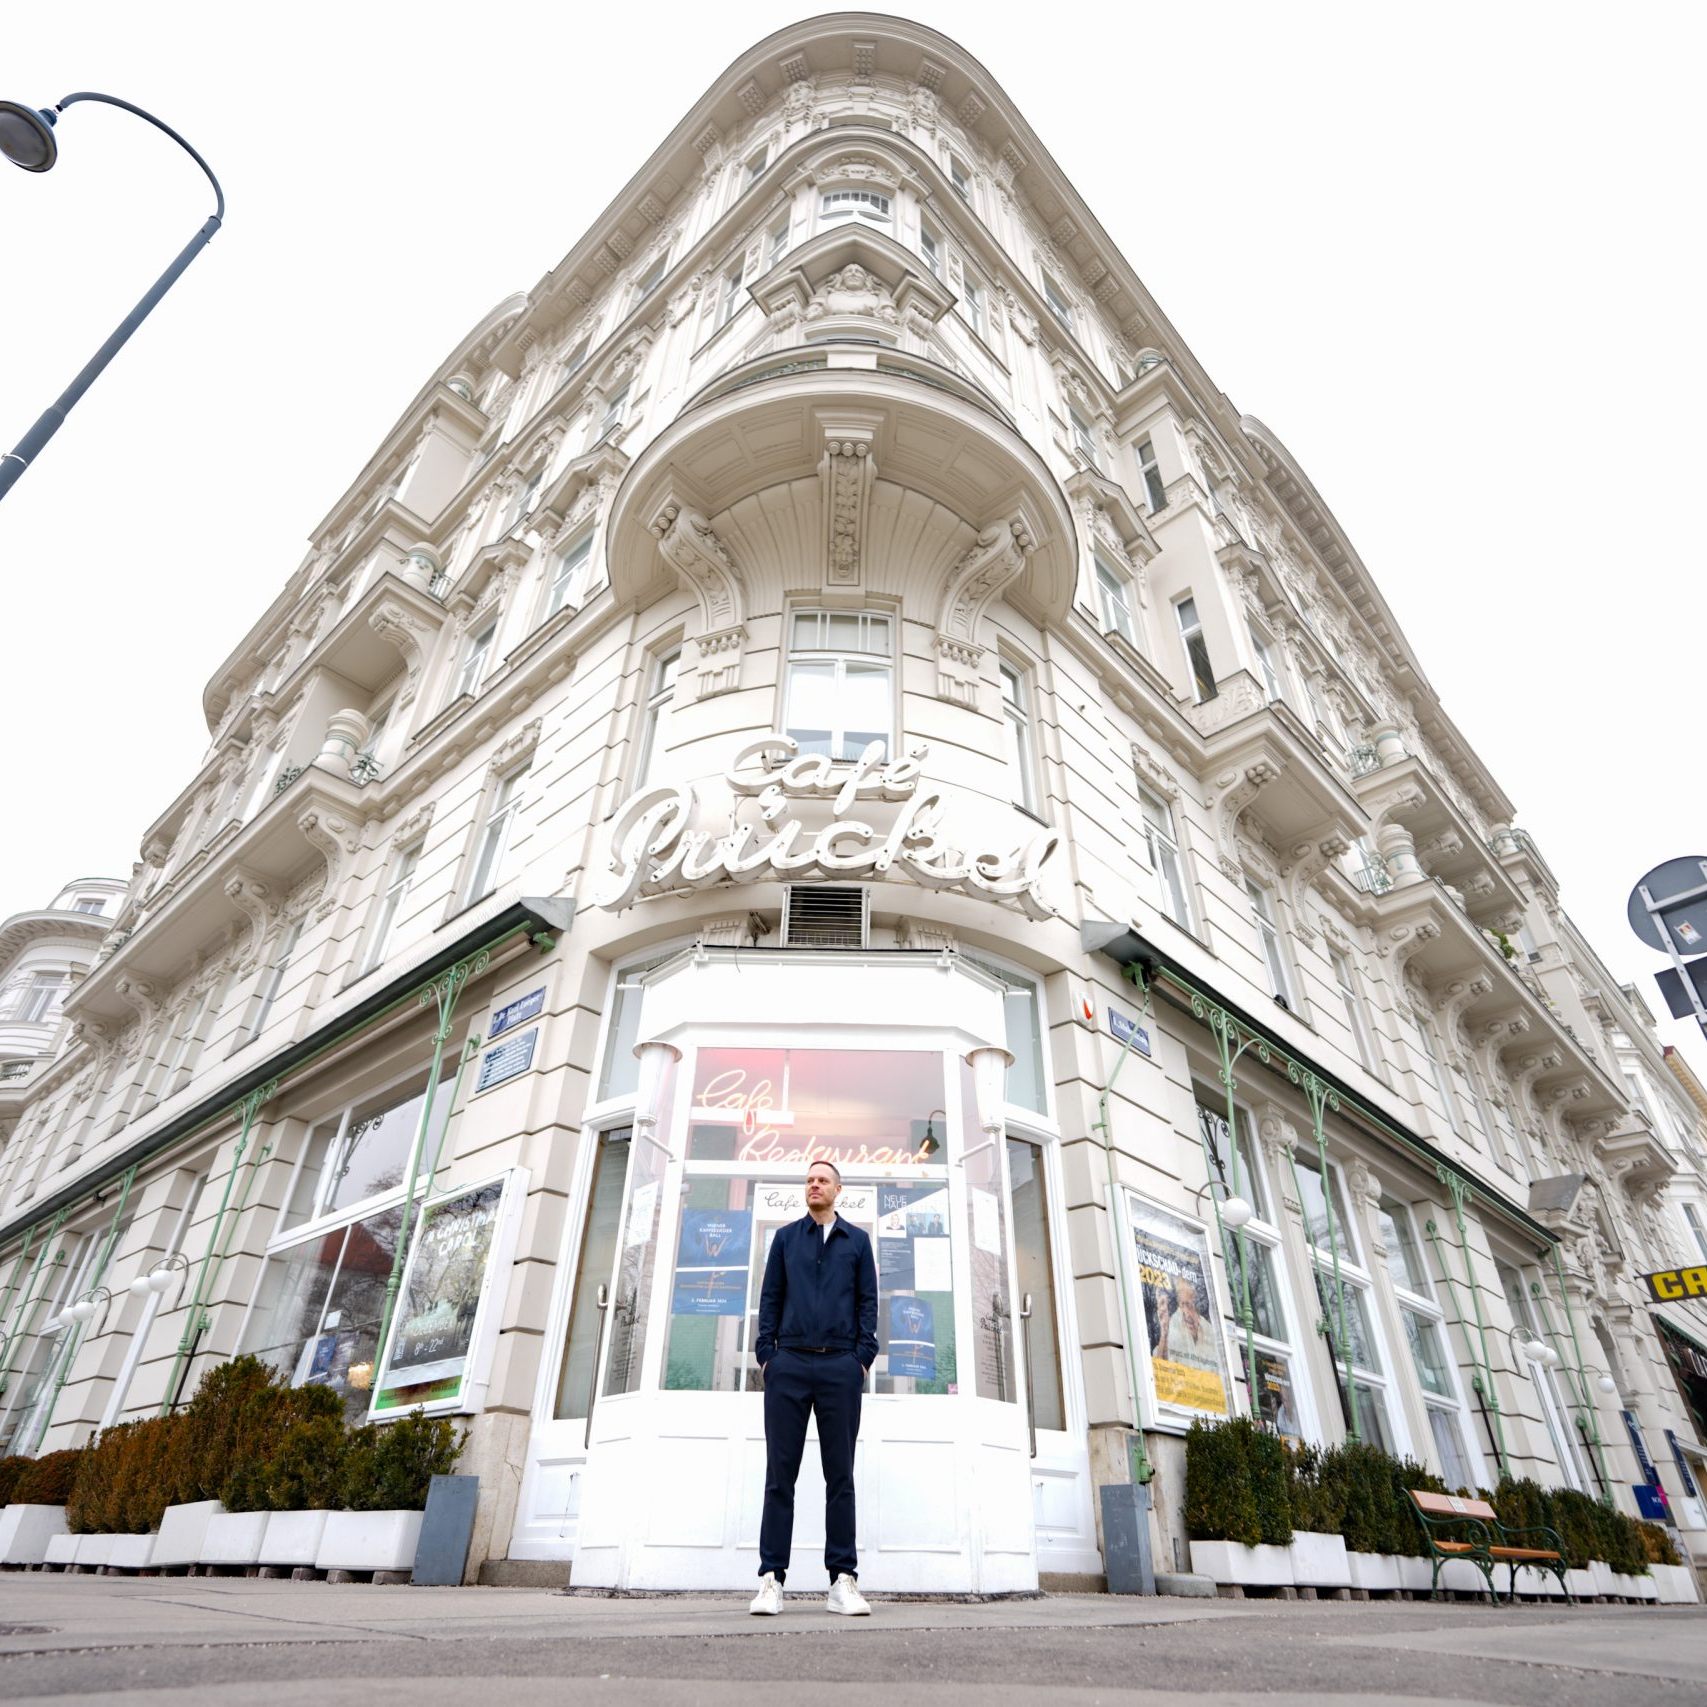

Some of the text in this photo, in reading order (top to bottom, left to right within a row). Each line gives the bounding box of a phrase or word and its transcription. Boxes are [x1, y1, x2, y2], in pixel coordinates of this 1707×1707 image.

[725, 734, 929, 816] Café
[591, 784, 1061, 921] Prückel
[437, 1208, 497, 1240] CHRISTMA
[1138, 1264, 1172, 1290] 2023
